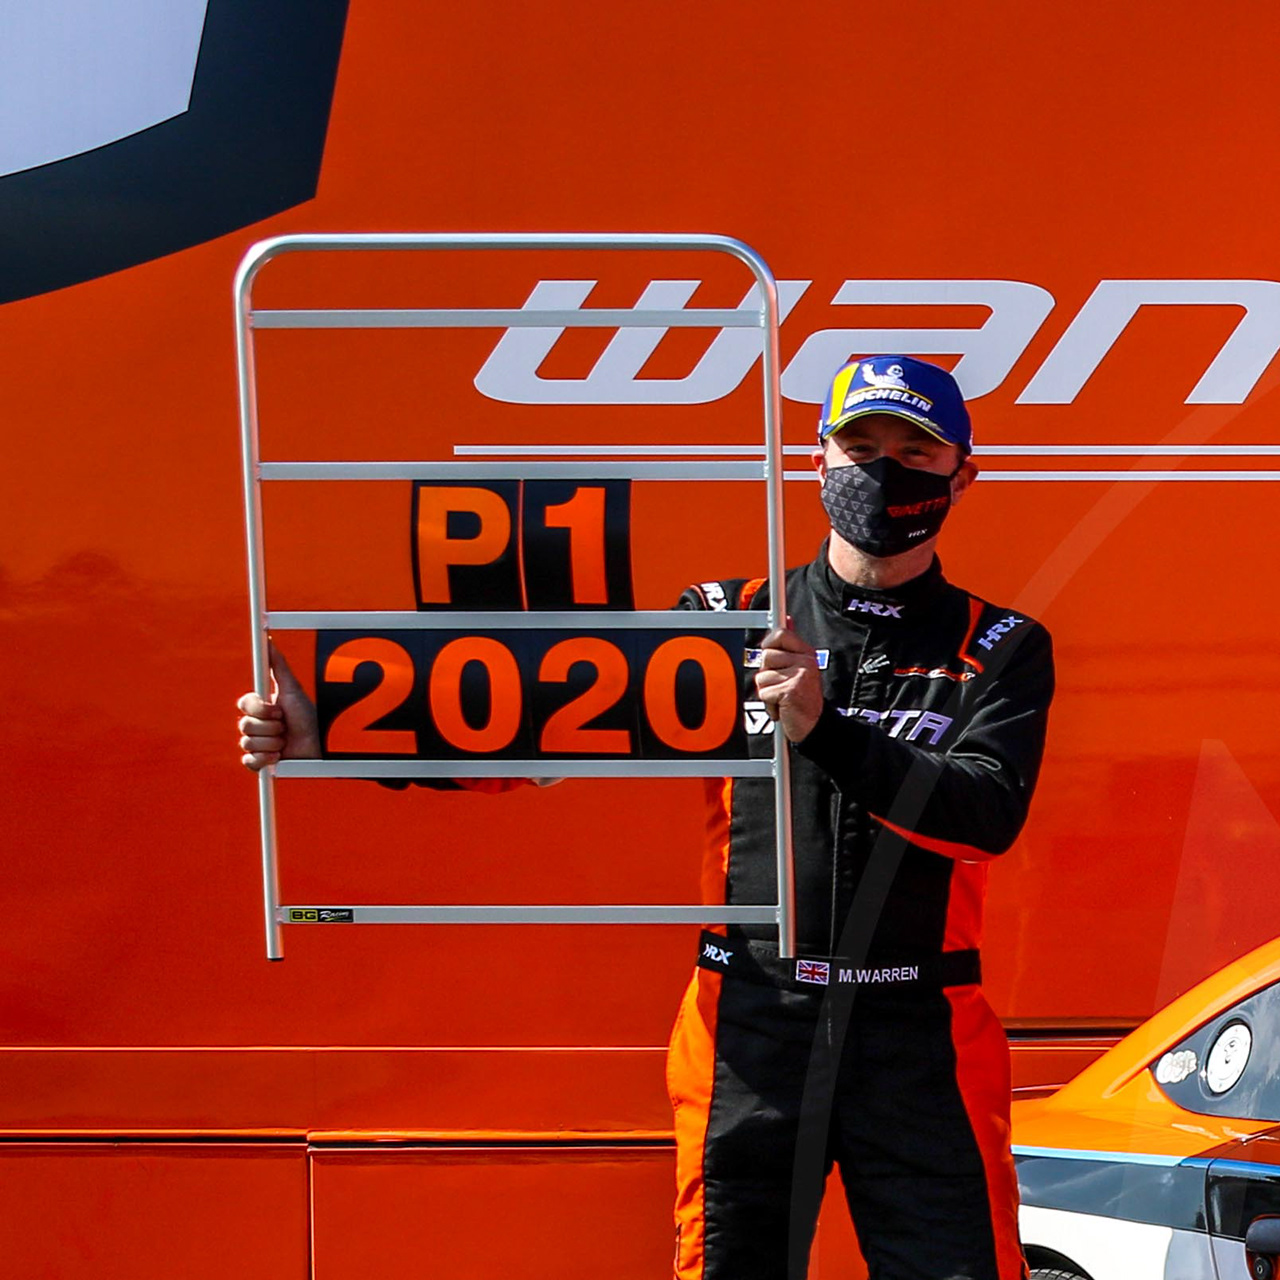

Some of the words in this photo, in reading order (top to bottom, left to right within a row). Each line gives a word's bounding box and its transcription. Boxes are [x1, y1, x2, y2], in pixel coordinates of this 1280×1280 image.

[844, 389, 931, 412] MICHELIN
[847, 599, 905, 619] HRX
[978, 615, 1024, 651] HRX
[323, 636, 736, 755] 2020
[838, 966, 919, 983] M.WARREN
